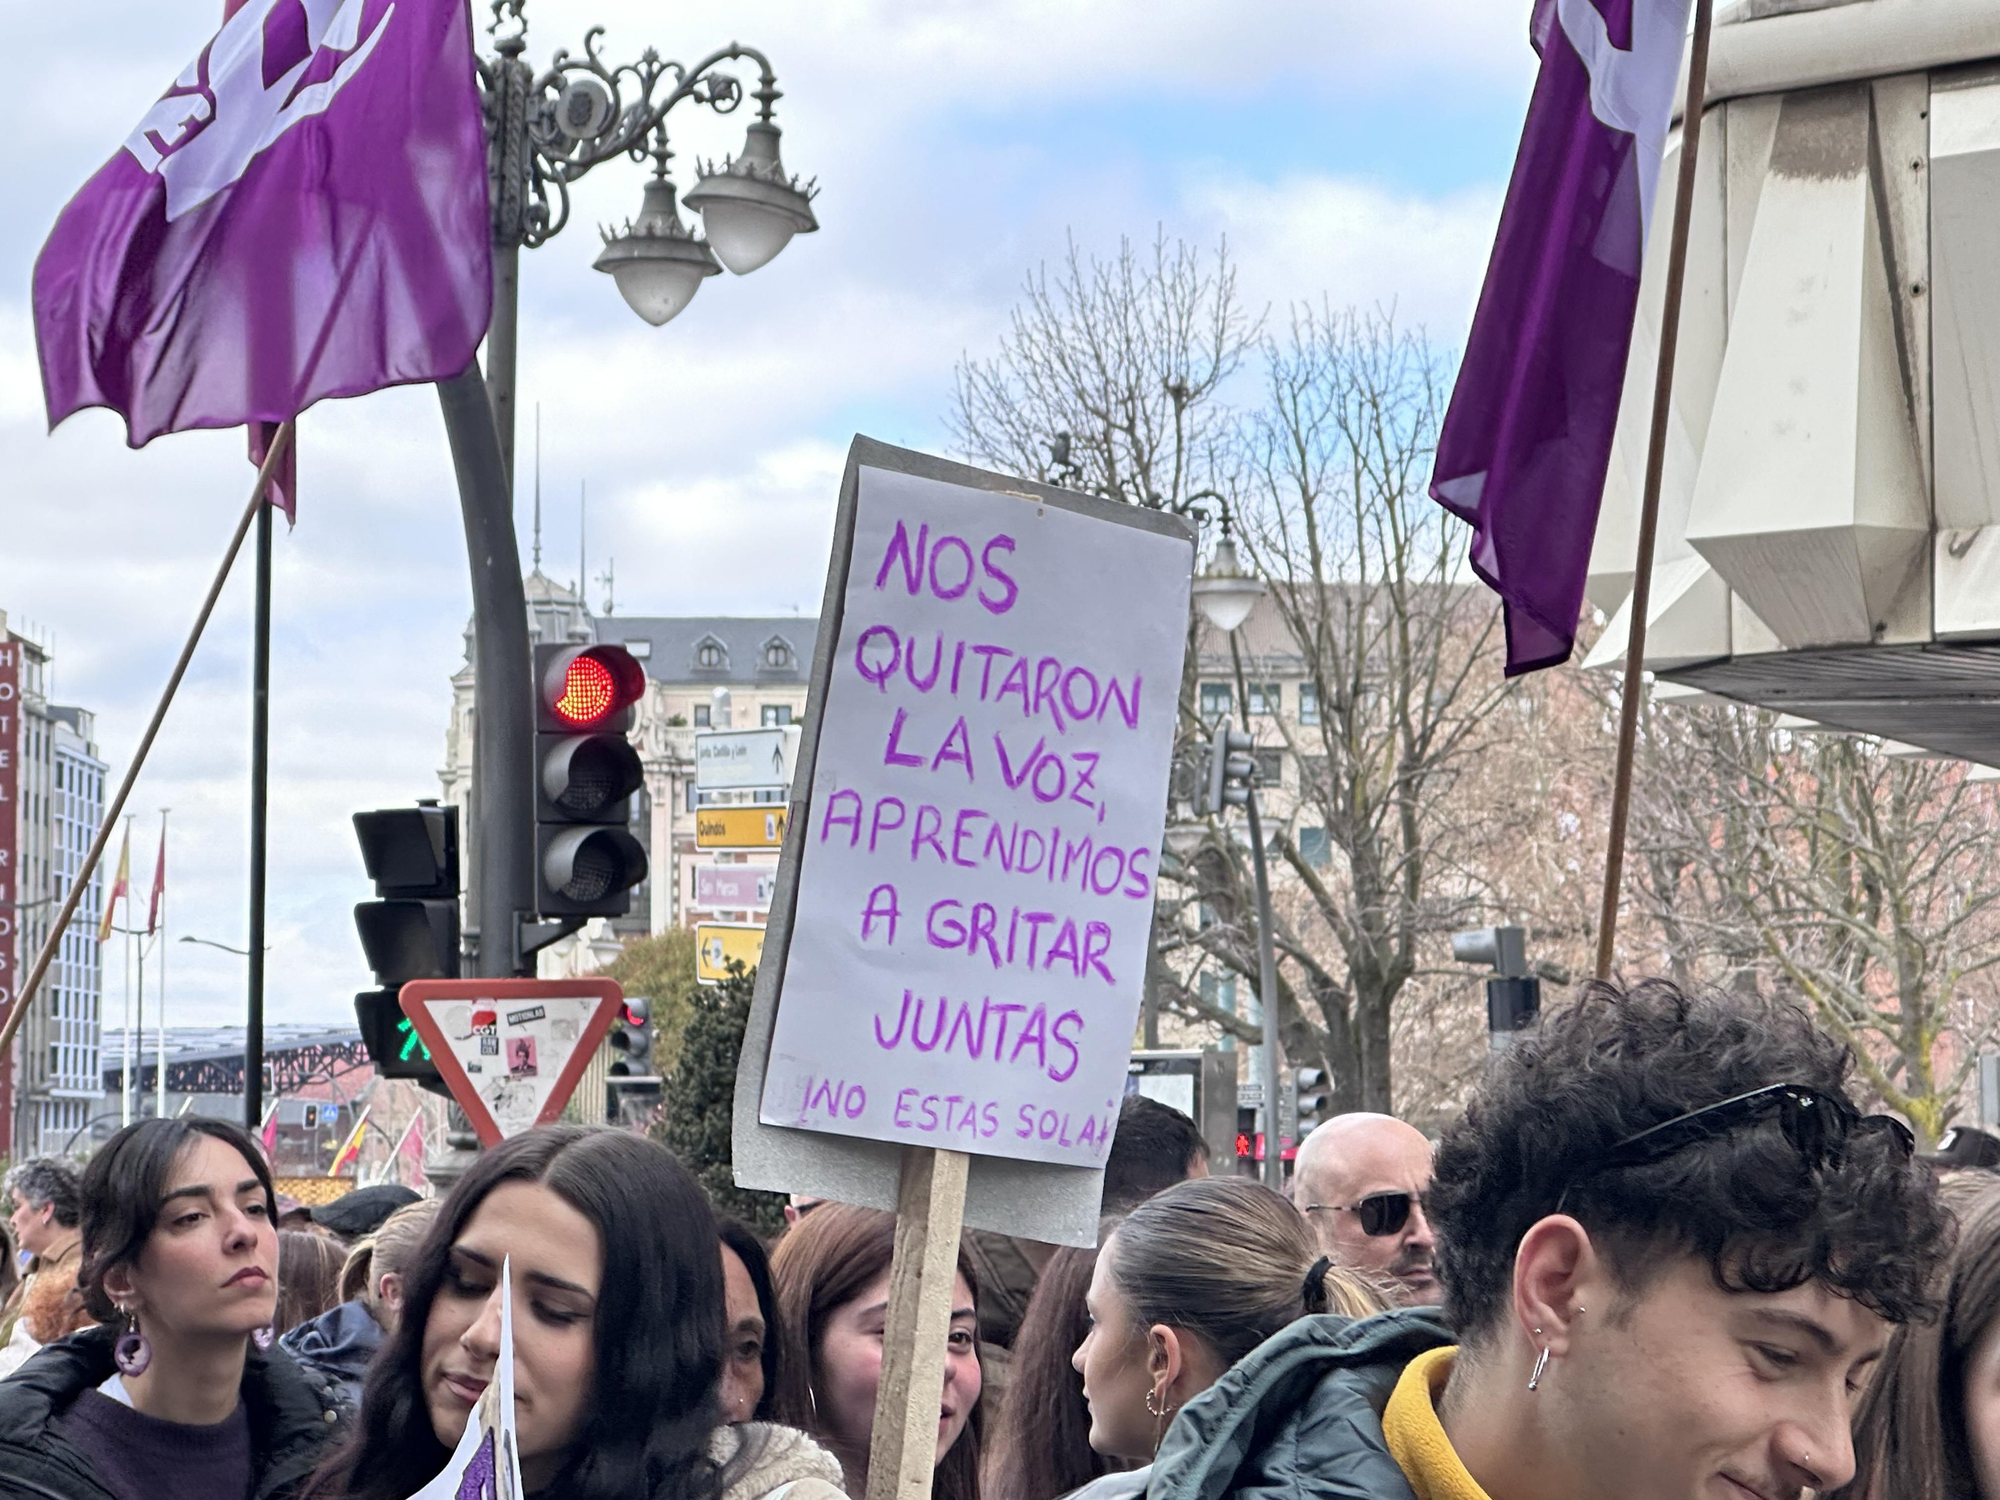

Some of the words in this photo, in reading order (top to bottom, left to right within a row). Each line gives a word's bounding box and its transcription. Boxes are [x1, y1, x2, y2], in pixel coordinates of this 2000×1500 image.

[874, 519, 1019, 616] NOS
[855, 624, 1143, 735] QUITARON
[884, 706, 975, 783] LA
[993, 731, 1106, 824] VOZ,
[820, 788, 1151, 900] APRENDIMOS
[861, 883, 902, 946] A
[926, 898, 1116, 985] GRITAR
[472, 1024, 497, 1036] CGT
[873, 988, 1085, 1083] JUNTAS
[894, 1086, 999, 1139] ESTAS
